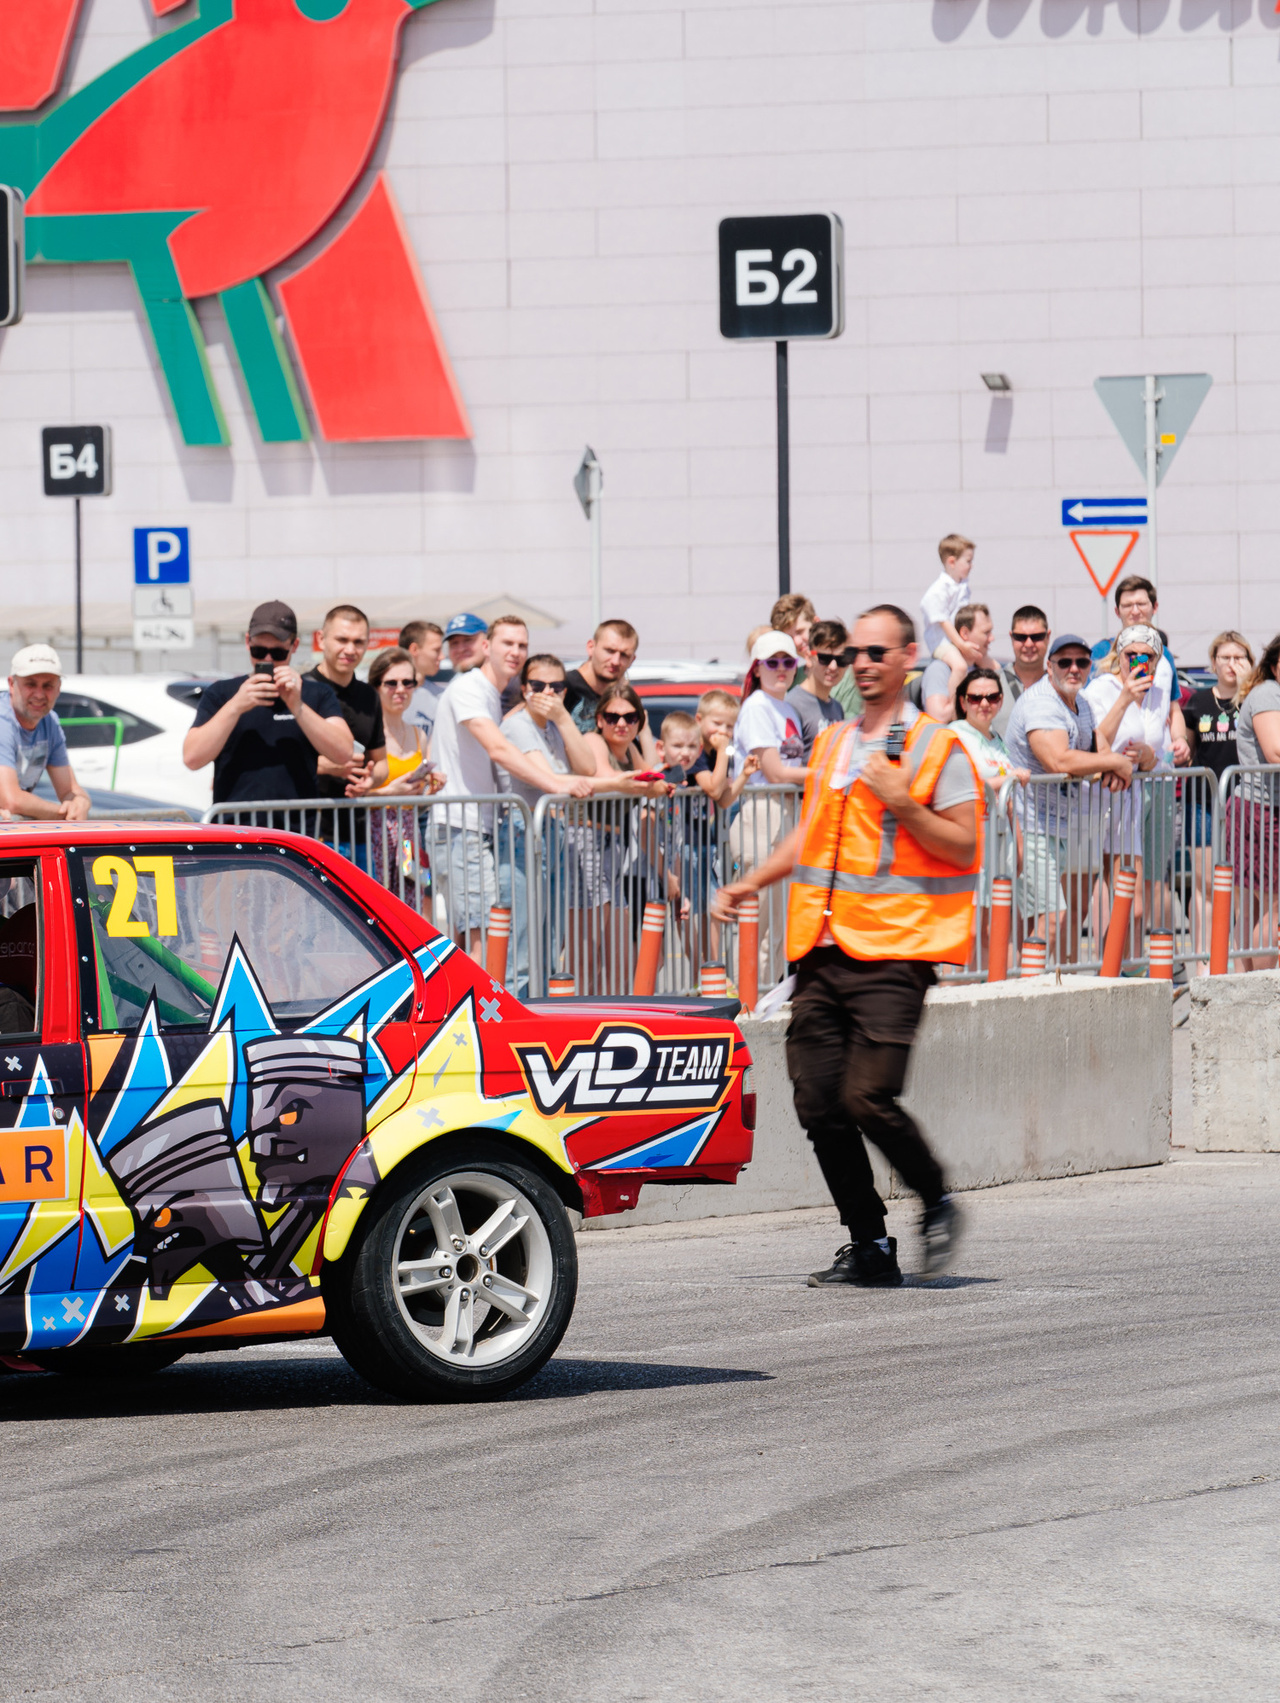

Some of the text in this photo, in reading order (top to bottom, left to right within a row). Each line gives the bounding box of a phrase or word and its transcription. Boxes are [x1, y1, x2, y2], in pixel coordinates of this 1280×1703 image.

[735, 248, 818, 306] Б2
[49, 443, 99, 480] Б4
[147, 531, 182, 580] P
[92, 855, 178, 937] 27
[656, 1045, 724, 1082] TEAM
